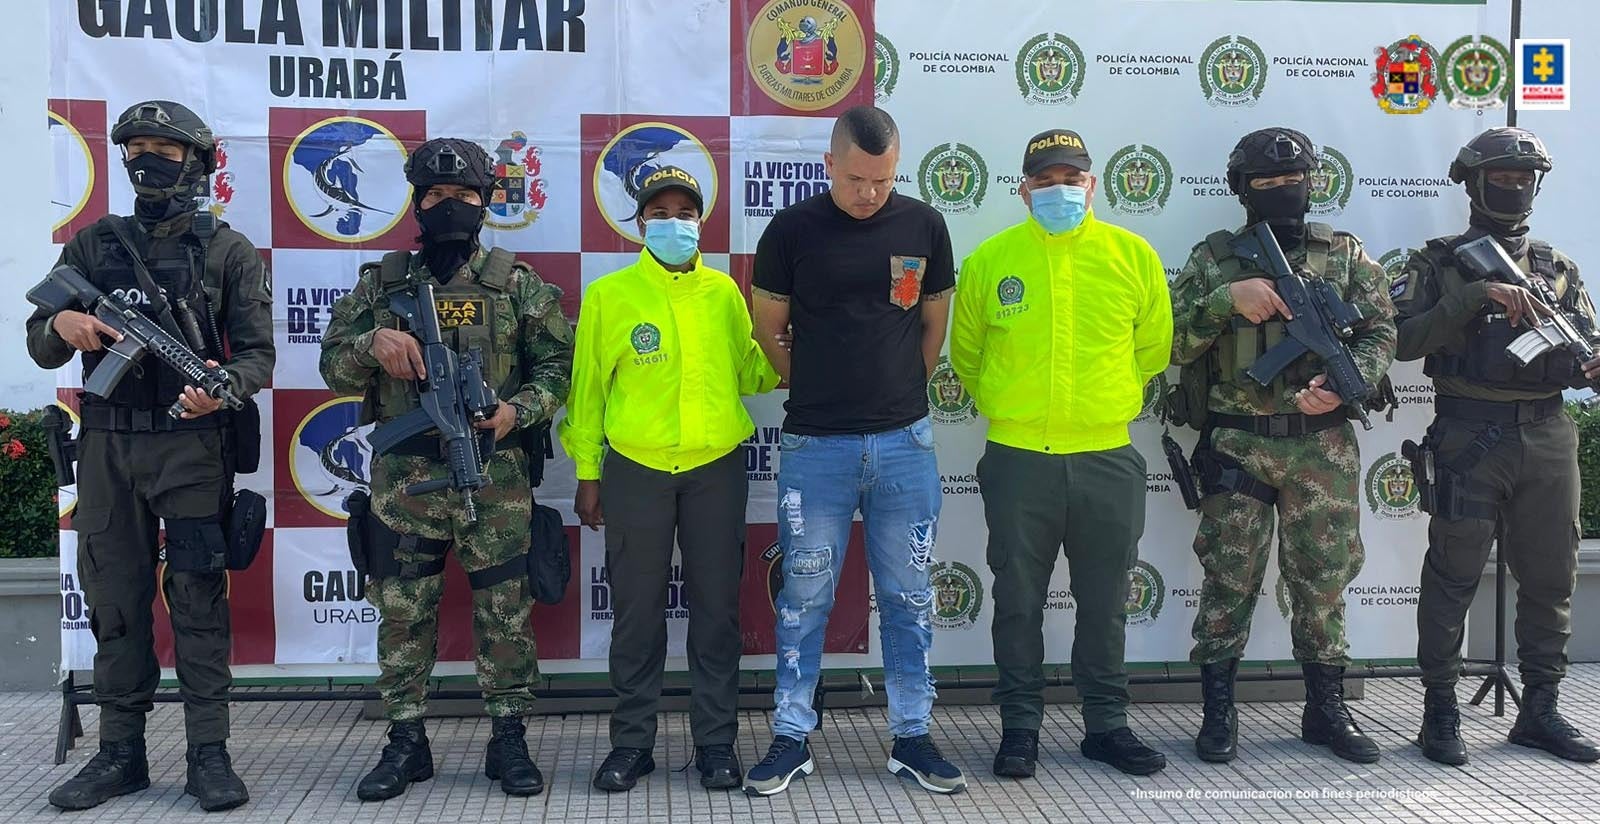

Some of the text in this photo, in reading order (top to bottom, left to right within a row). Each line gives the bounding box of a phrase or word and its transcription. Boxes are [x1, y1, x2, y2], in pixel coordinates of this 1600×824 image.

[766, 0, 847, 22] COMANDO GENERAL
[78, 0, 586, 53] GAULA MILITAR
[909, 51, 1009, 61] POLICÍA NACIONAL
[1096, 53, 1193, 64] POLICÍA NACIONAL
[1273, 55, 1368, 66] POLICÍA NACIONAL
[923, 64, 995, 73] DE COLOMBIA
[1109, 66, 1180, 75] DE COLOMBIA
[1286, 68, 1355, 78] DE COLOMBIA
[269, 52, 407, 100] URABÁ
[758, 64, 782, 92] FUERZAS
[779, 85, 816, 102] MILITARES
[815, 91, 826, 101] DE
[825, 67, 854, 97] COLOMBIA
[1029, 134, 1083, 154] POLICIA
[744, 161, 763, 179] LA
[644, 168, 698, 188] POLICIA
[1180, 174, 1220, 184] POLICÍA
[1359, 175, 1452, 187] POLICÍA NACIONAL
[744, 180, 773, 207] DE
[1193, 188, 1206, 196] DE
[1371, 189, 1439, 198] DE COLOMBIA
[744, 208, 774, 217] FUERZAS
[287, 288, 307, 305] LA
[287, 307, 321, 334] DE
[287, 335, 322, 344] FUERZAS
[745, 446, 772, 472] DE
[1348, 585, 1388, 595] POLICÍA
[1185, 600, 1198, 608] DE
[1361, 598, 1374, 606] DE
